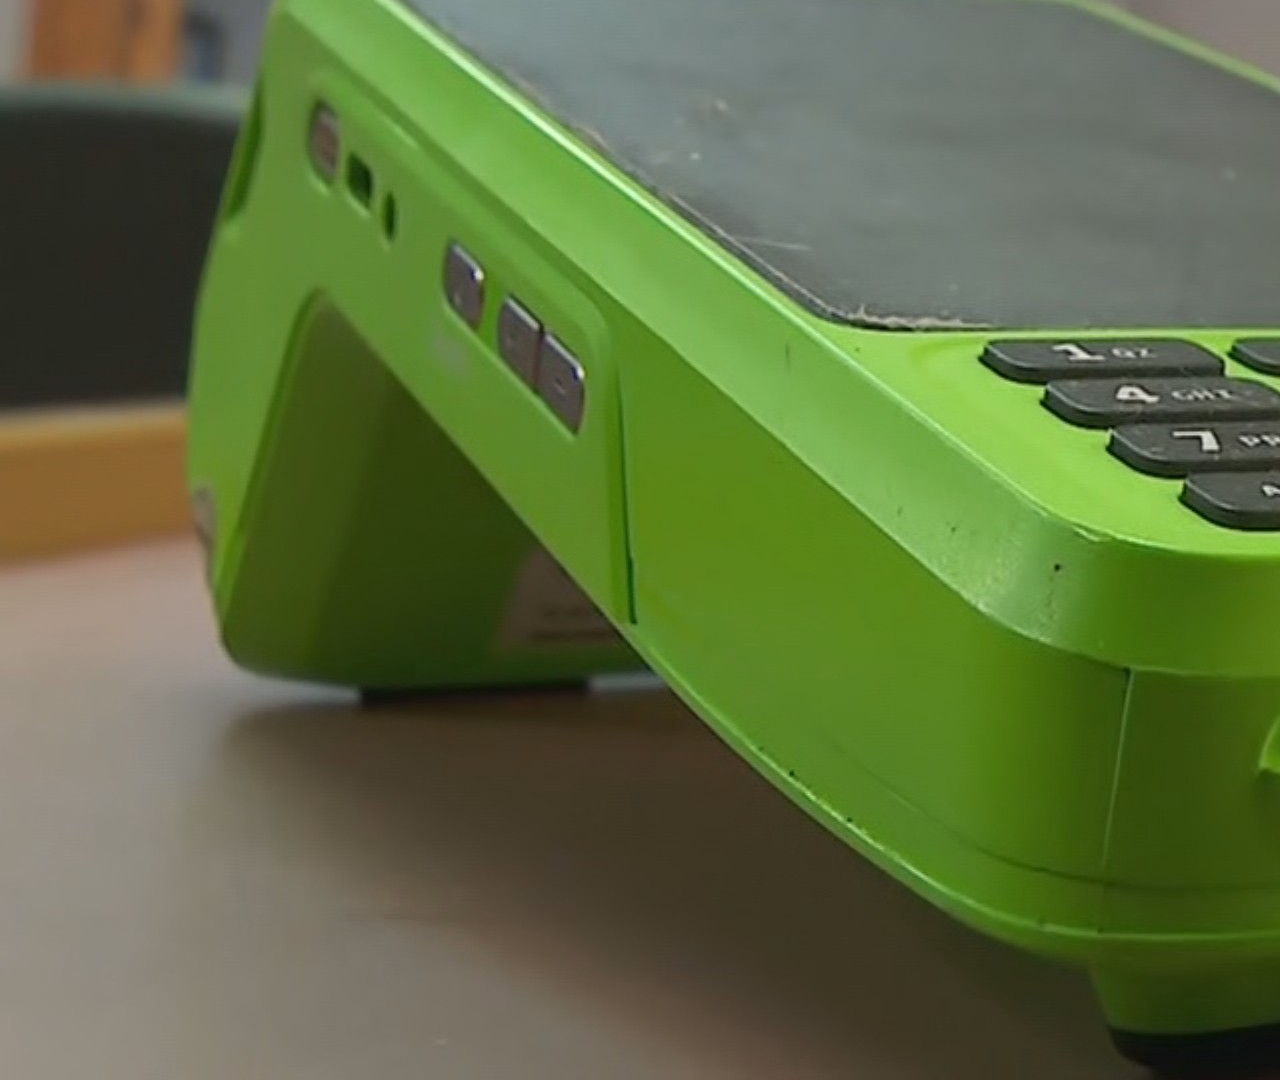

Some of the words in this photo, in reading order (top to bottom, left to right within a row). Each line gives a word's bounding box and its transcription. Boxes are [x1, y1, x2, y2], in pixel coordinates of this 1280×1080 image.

[1052, 343, 1107, 361] 1
[1114, 385, 1161, 403] 4
[1172, 430, 1221, 452] 7
